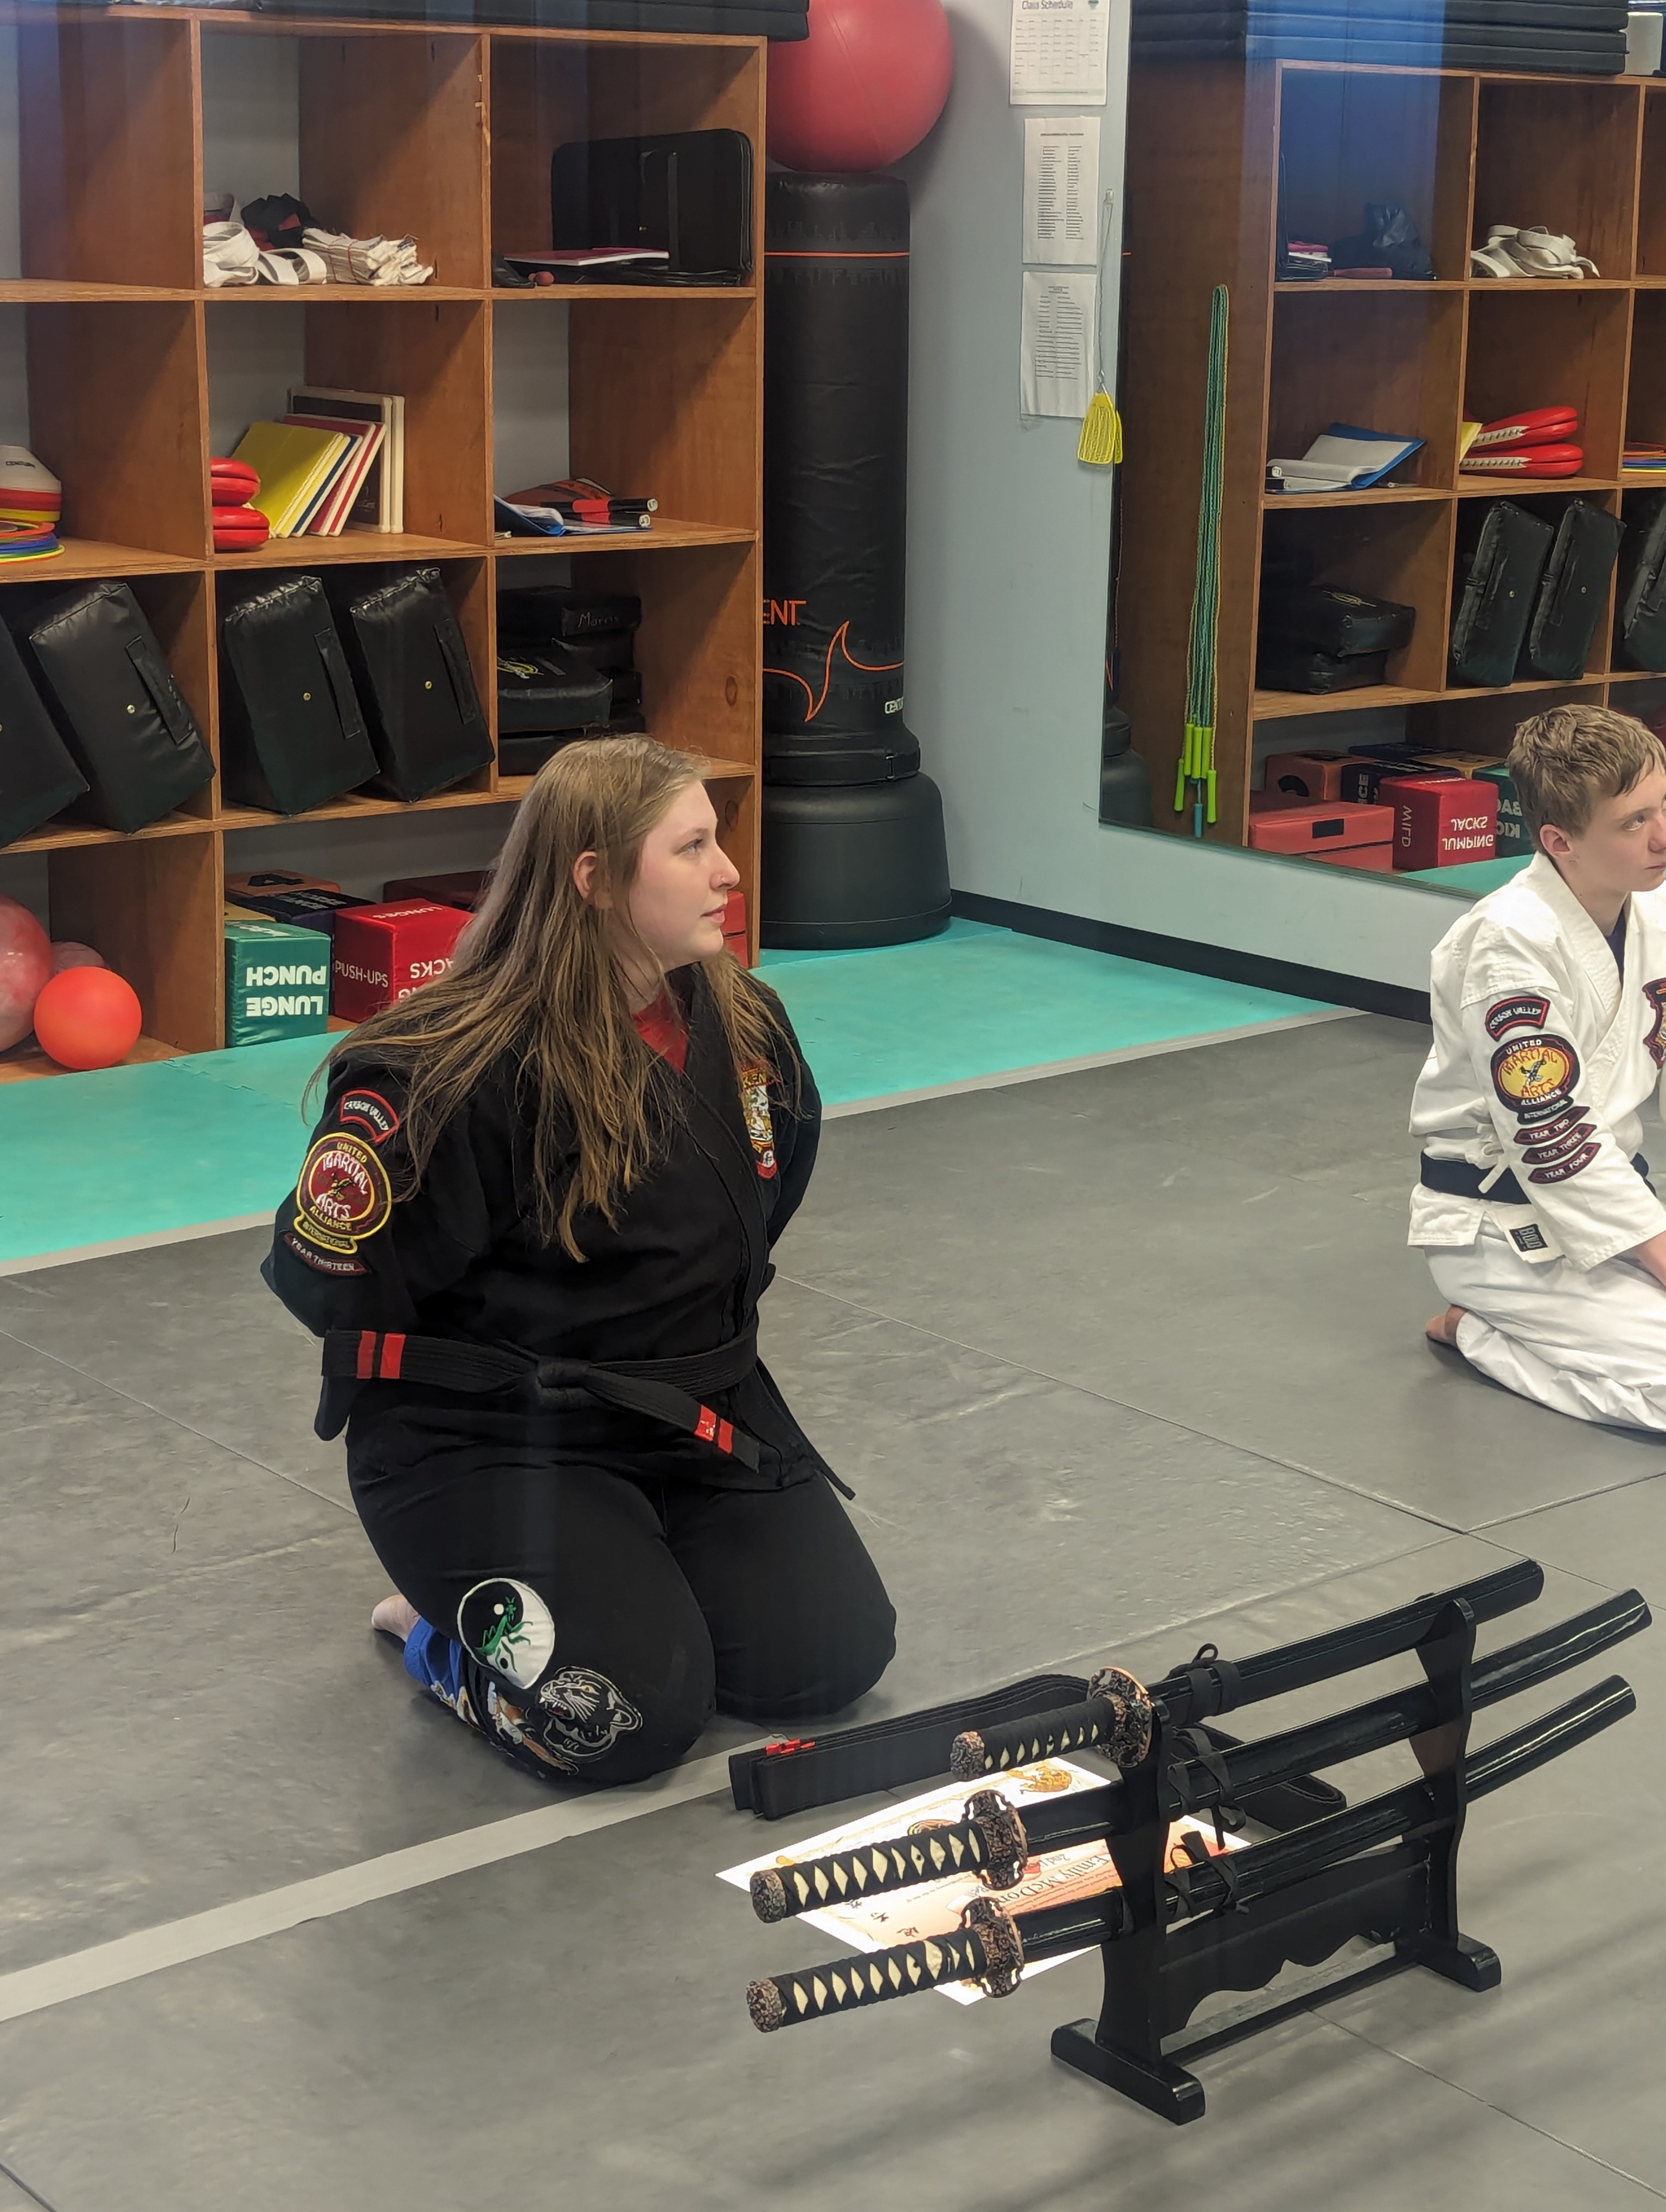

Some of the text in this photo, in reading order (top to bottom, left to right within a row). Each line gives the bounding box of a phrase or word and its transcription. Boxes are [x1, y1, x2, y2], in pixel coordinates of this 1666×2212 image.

[246, 964, 327, 987] PUNCH
[335, 960, 388, 988] PUSH-UPS
[246, 995, 324, 1017] LUNGE
[1505, 1039, 1542, 1055] UNITED
[1502, 1047, 1558, 1076] MARTIAL
[1520, 1078, 1555, 1097] ARTS
[1521, 1088, 1562, 1106] ALLIANCE
[1529, 1118, 1570, 1140] YEAR TWO
[336, 1142, 368, 1163] UNITED
[1537, 1148, 1560, 1159] YEAR
[323, 1152, 369, 1194] MARTIAL
[1544, 1153, 1589, 1179] YEAR FOUR
[316, 1193, 351, 1220] ARTS
[310, 1206, 352, 1231] ALLIANCE
[291, 1238, 311, 1259] YEAR
[1057, 1855, 1110, 1881] Emily
